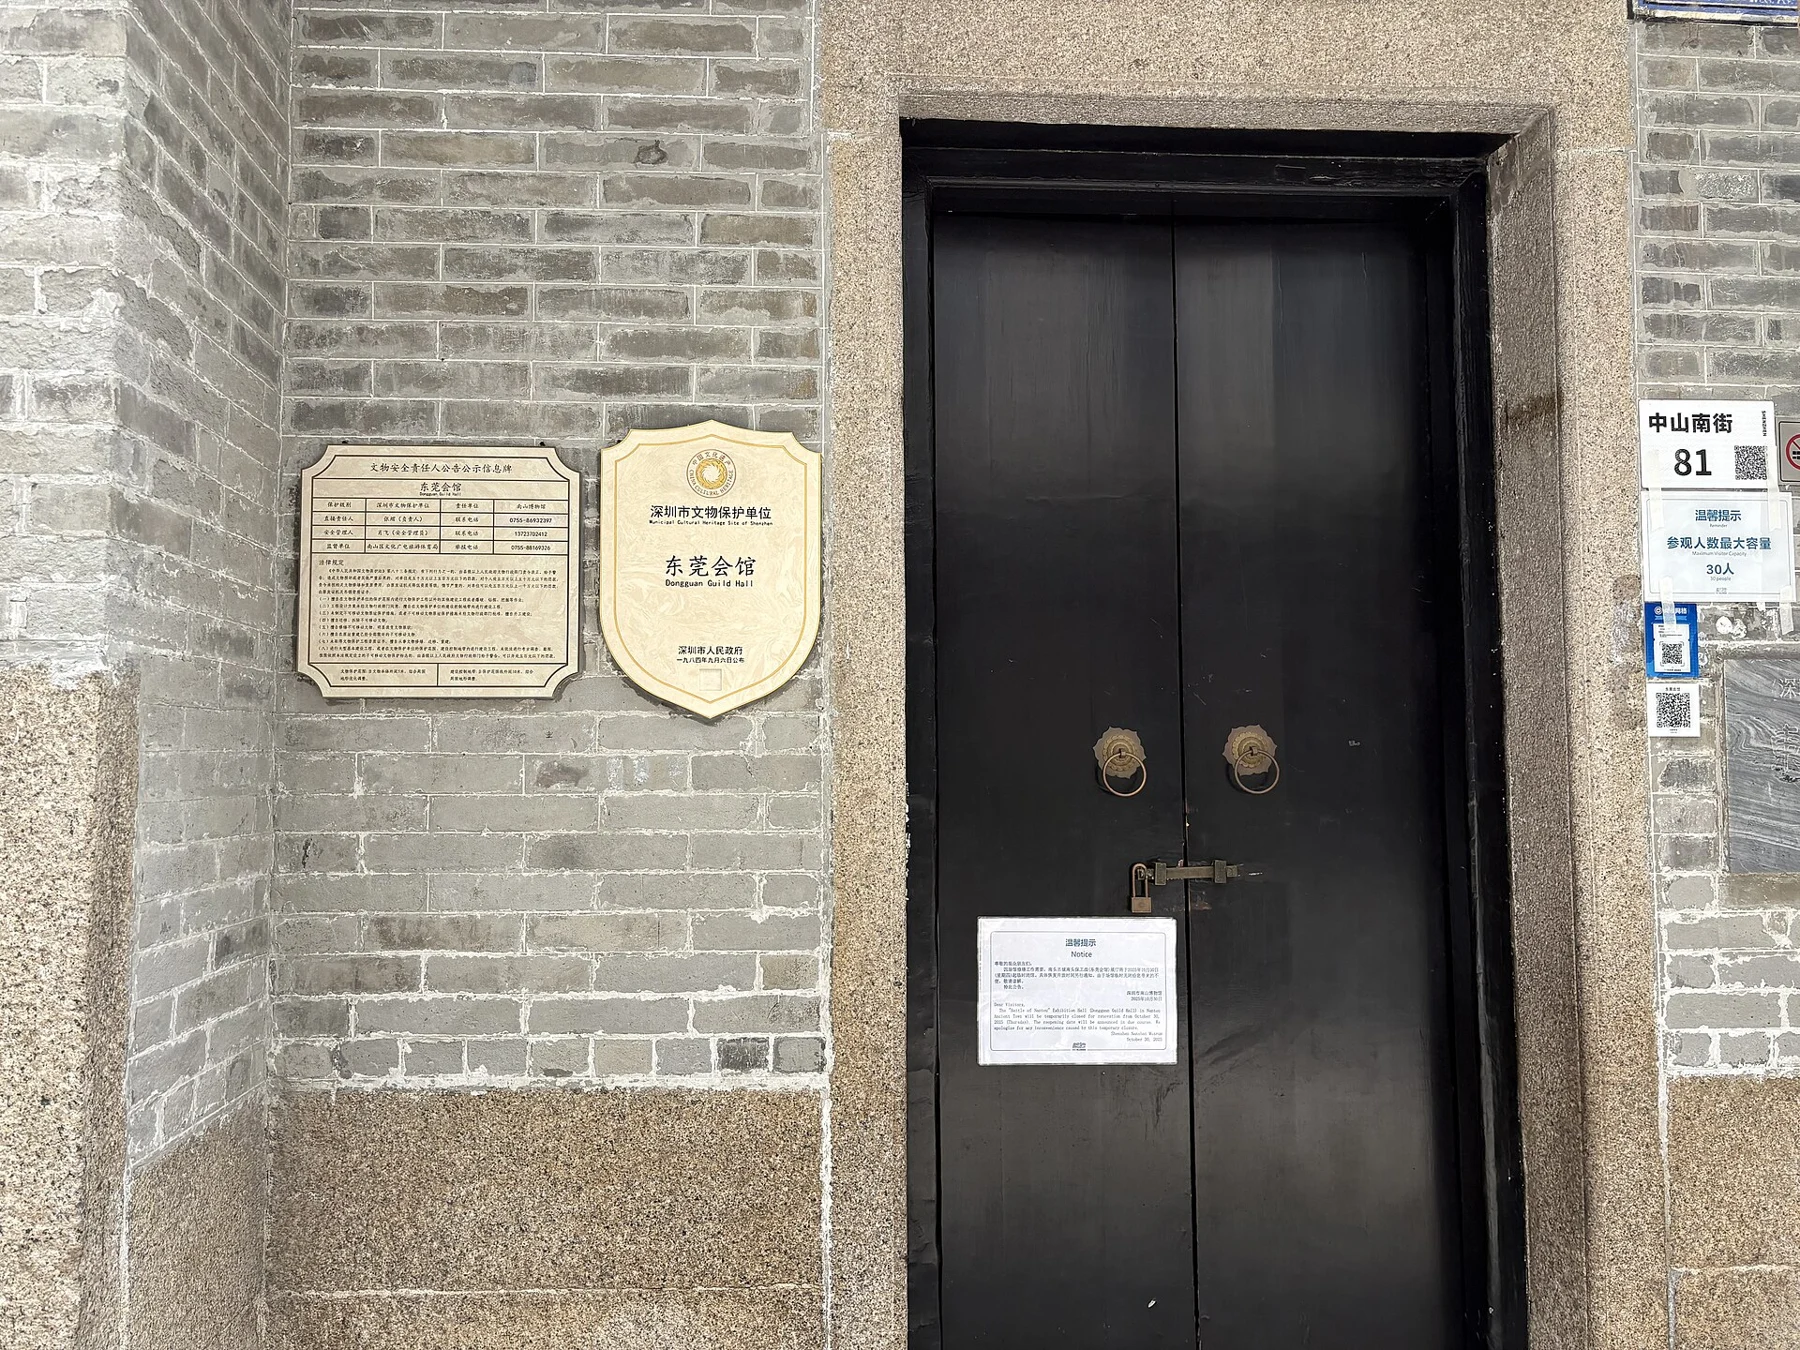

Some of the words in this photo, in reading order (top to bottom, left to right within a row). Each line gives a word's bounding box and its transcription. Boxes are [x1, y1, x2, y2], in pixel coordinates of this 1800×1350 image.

[1648, 412, 1732, 434] 中山南街
[370, 463, 512, 474] 文物安全责任人公告公示信息牌
[1674, 448, 1712, 476] 81
[420, 482, 462, 492] 东莞会馆
[650, 505, 772, 520] 深圳市文物保护单位
[1695, 509, 1742, 522] 温馨提示
[1667, 536, 1771, 550] 参观人数最大容量
[666, 555, 756, 576] 东莞会馆
[1706, 562, 1734, 575] 30人
[666, 579, 703, 588] Dongguan
[678, 646, 743, 655] 深圳市人民政府
[1066, 938, 1096, 947] 温馨提示
